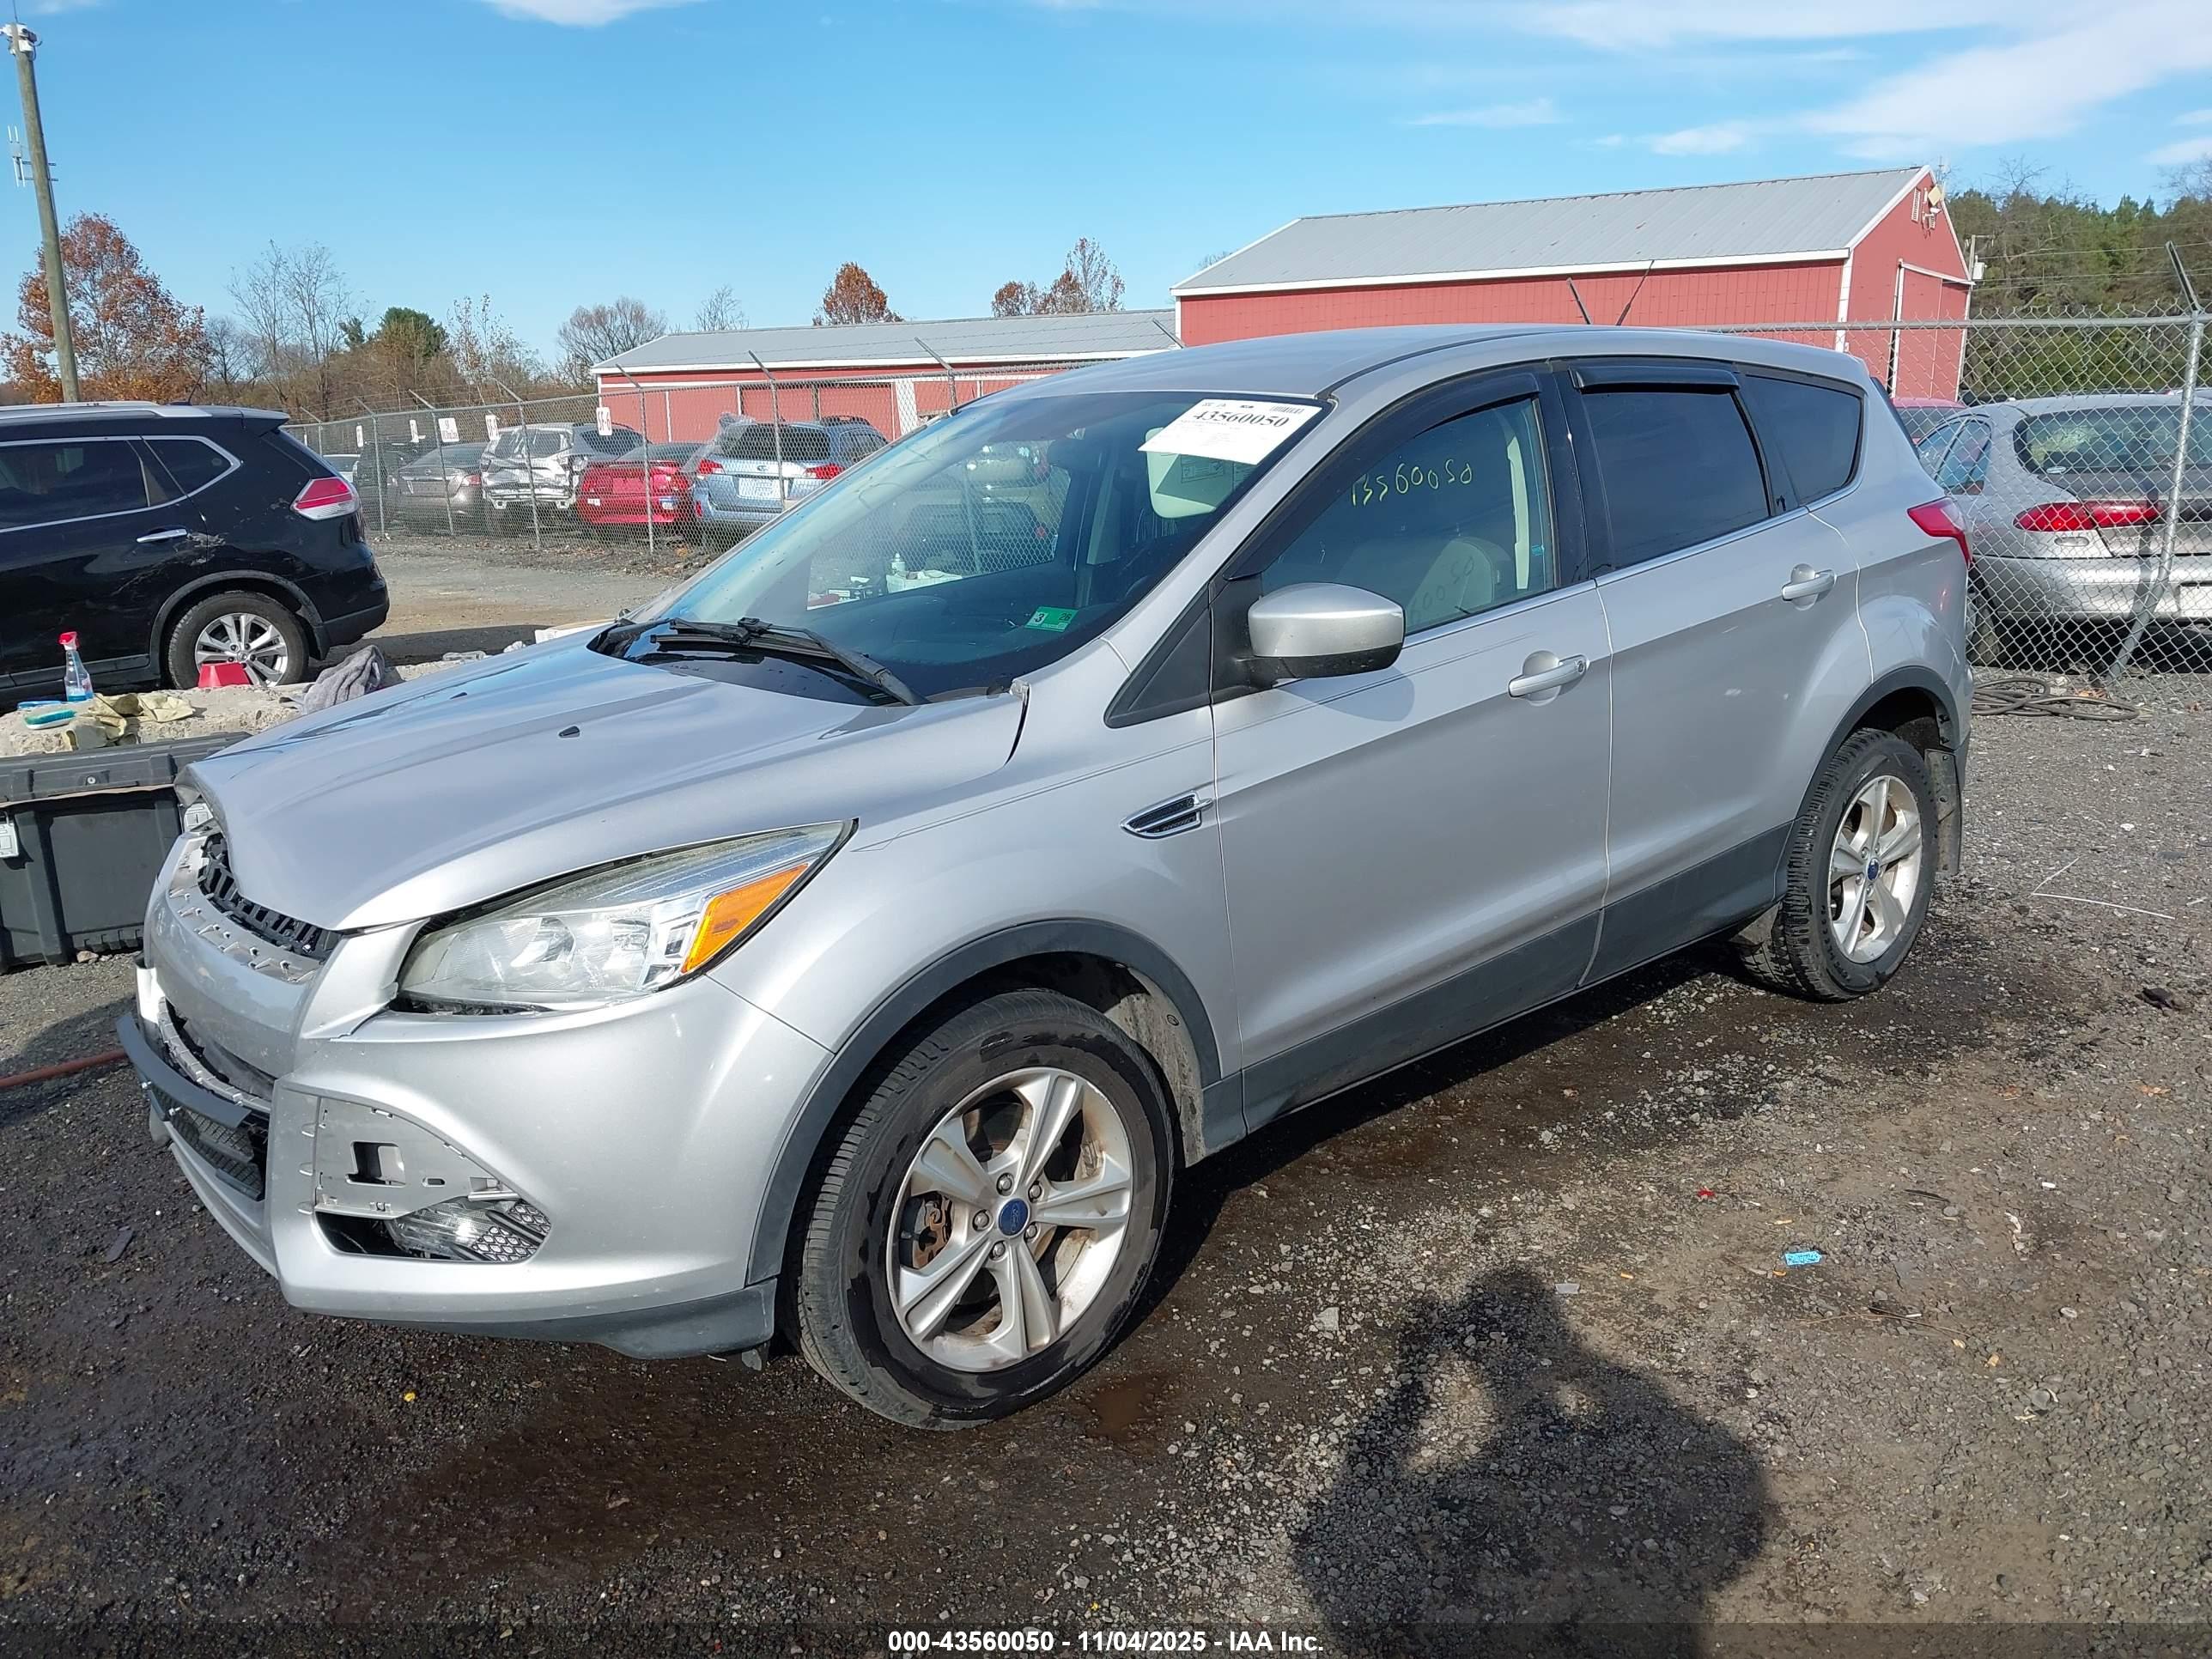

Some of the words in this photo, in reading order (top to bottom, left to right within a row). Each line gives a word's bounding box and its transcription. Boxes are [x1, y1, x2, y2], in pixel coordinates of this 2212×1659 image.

[1194, 410, 1290, 428] 43560050
[1035, 613, 1045, 622] 3
[1058, 612, 1073, 622] 26
